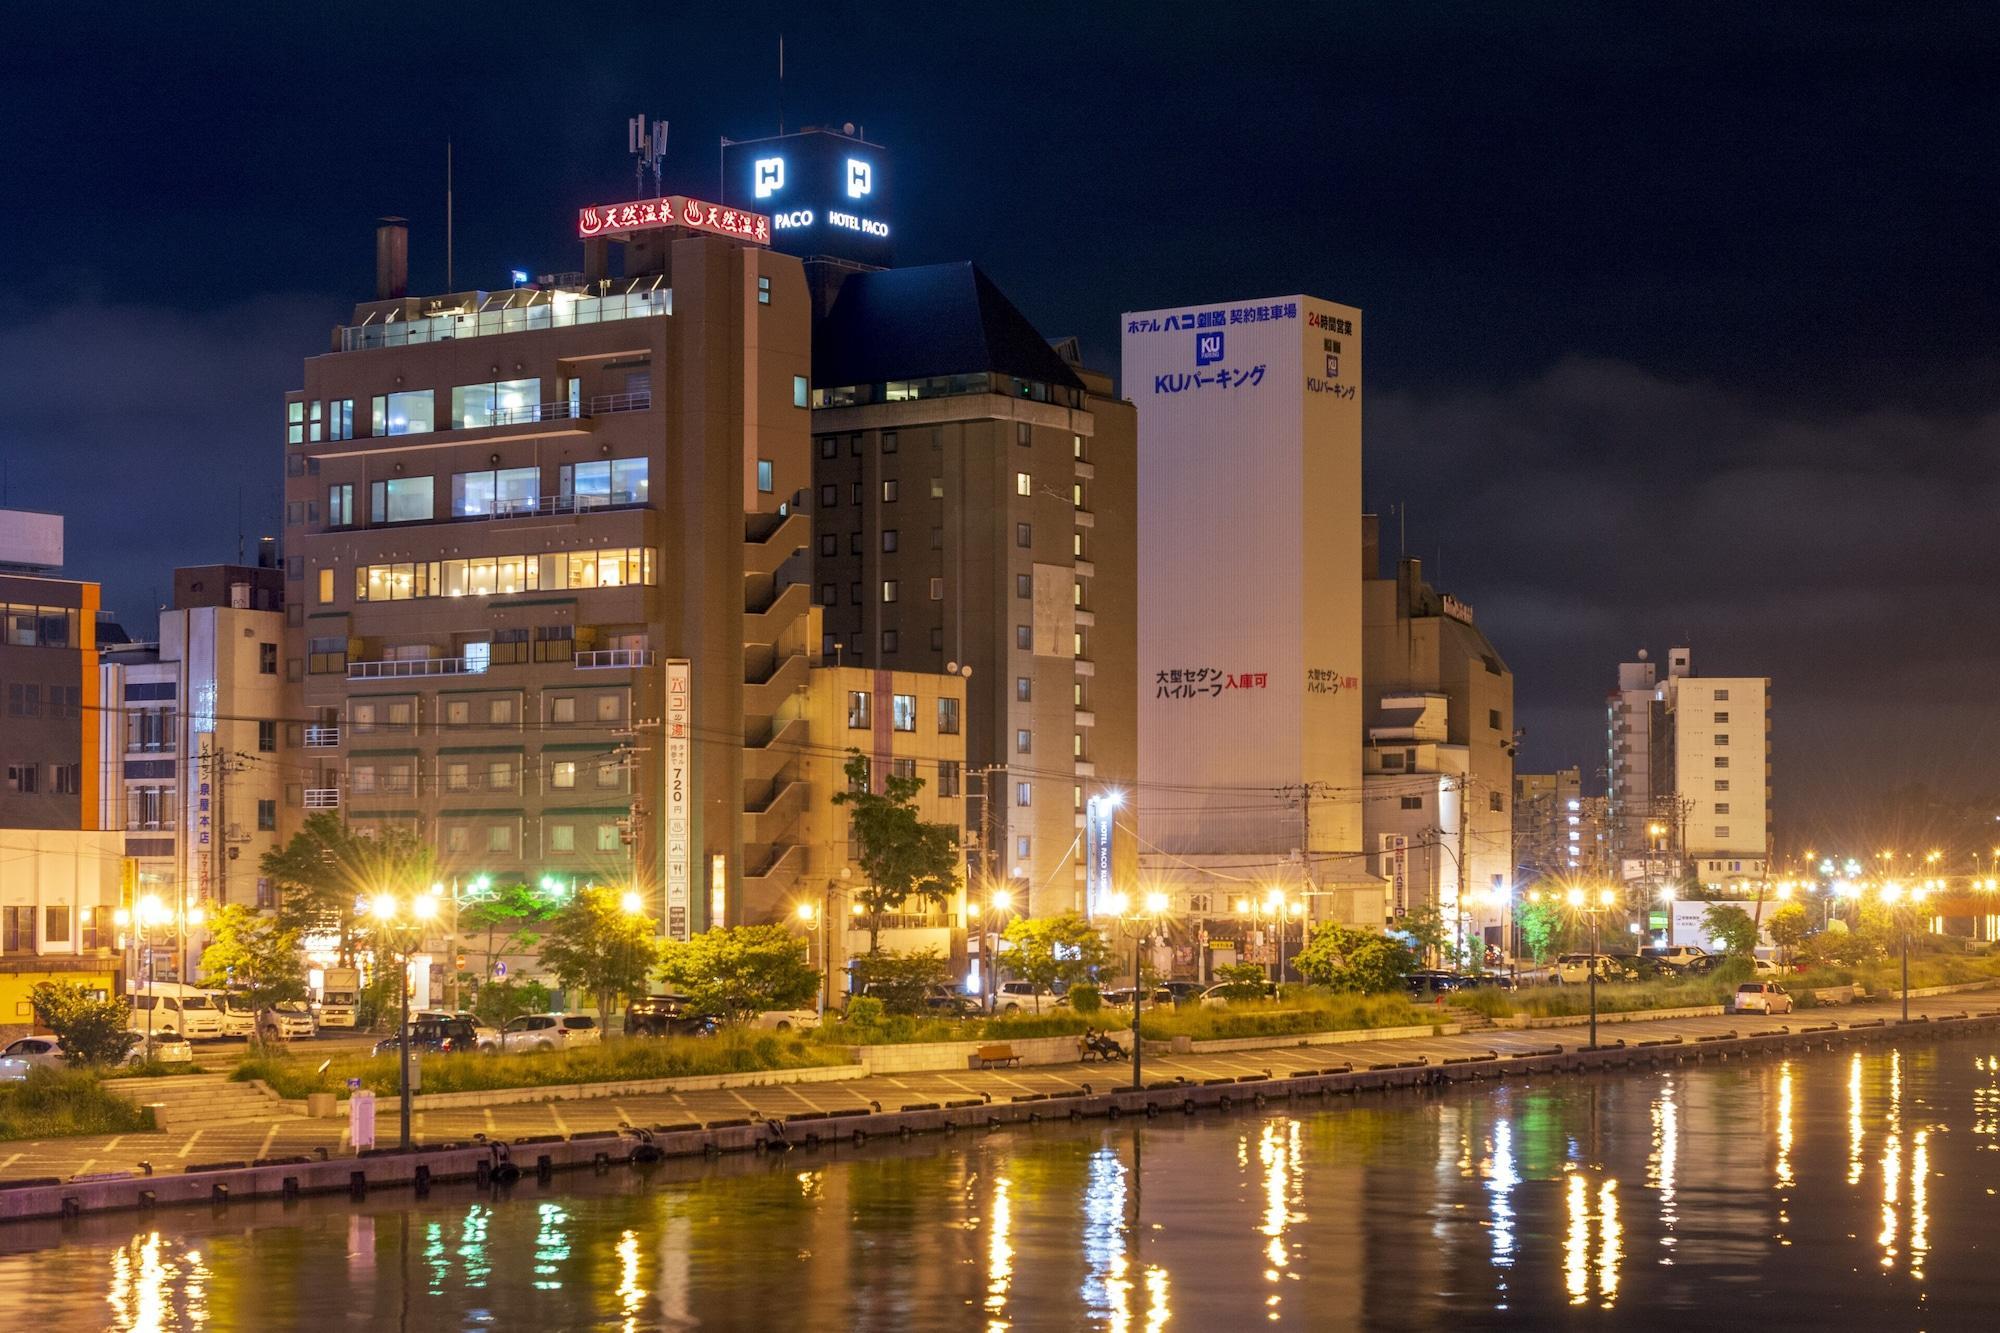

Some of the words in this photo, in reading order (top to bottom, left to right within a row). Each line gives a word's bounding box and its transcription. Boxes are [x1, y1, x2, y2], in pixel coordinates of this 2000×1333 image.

[604, 199, 674, 228] 天然温泉
[705, 207, 768, 240] 天然温泉
[775, 210, 813, 229] PACO
[829, 211, 860, 230] HOTEL
[862, 219, 889, 237] PACO
[1308, 311, 1353, 336] 24時間営業
[1201, 336, 1220, 353] KU
[1155, 364, 1266, 394] KUパーキング
[1307, 377, 1355, 400] KUパーキング
[1156, 668, 1223, 683] 大型セダン
[1225, 673, 1267, 689] 入庫可
[1156, 684, 1223, 699] ハイルーフ
[1100, 821, 1108, 846] HOTEL
[1100, 847, 1108, 869] PACO
